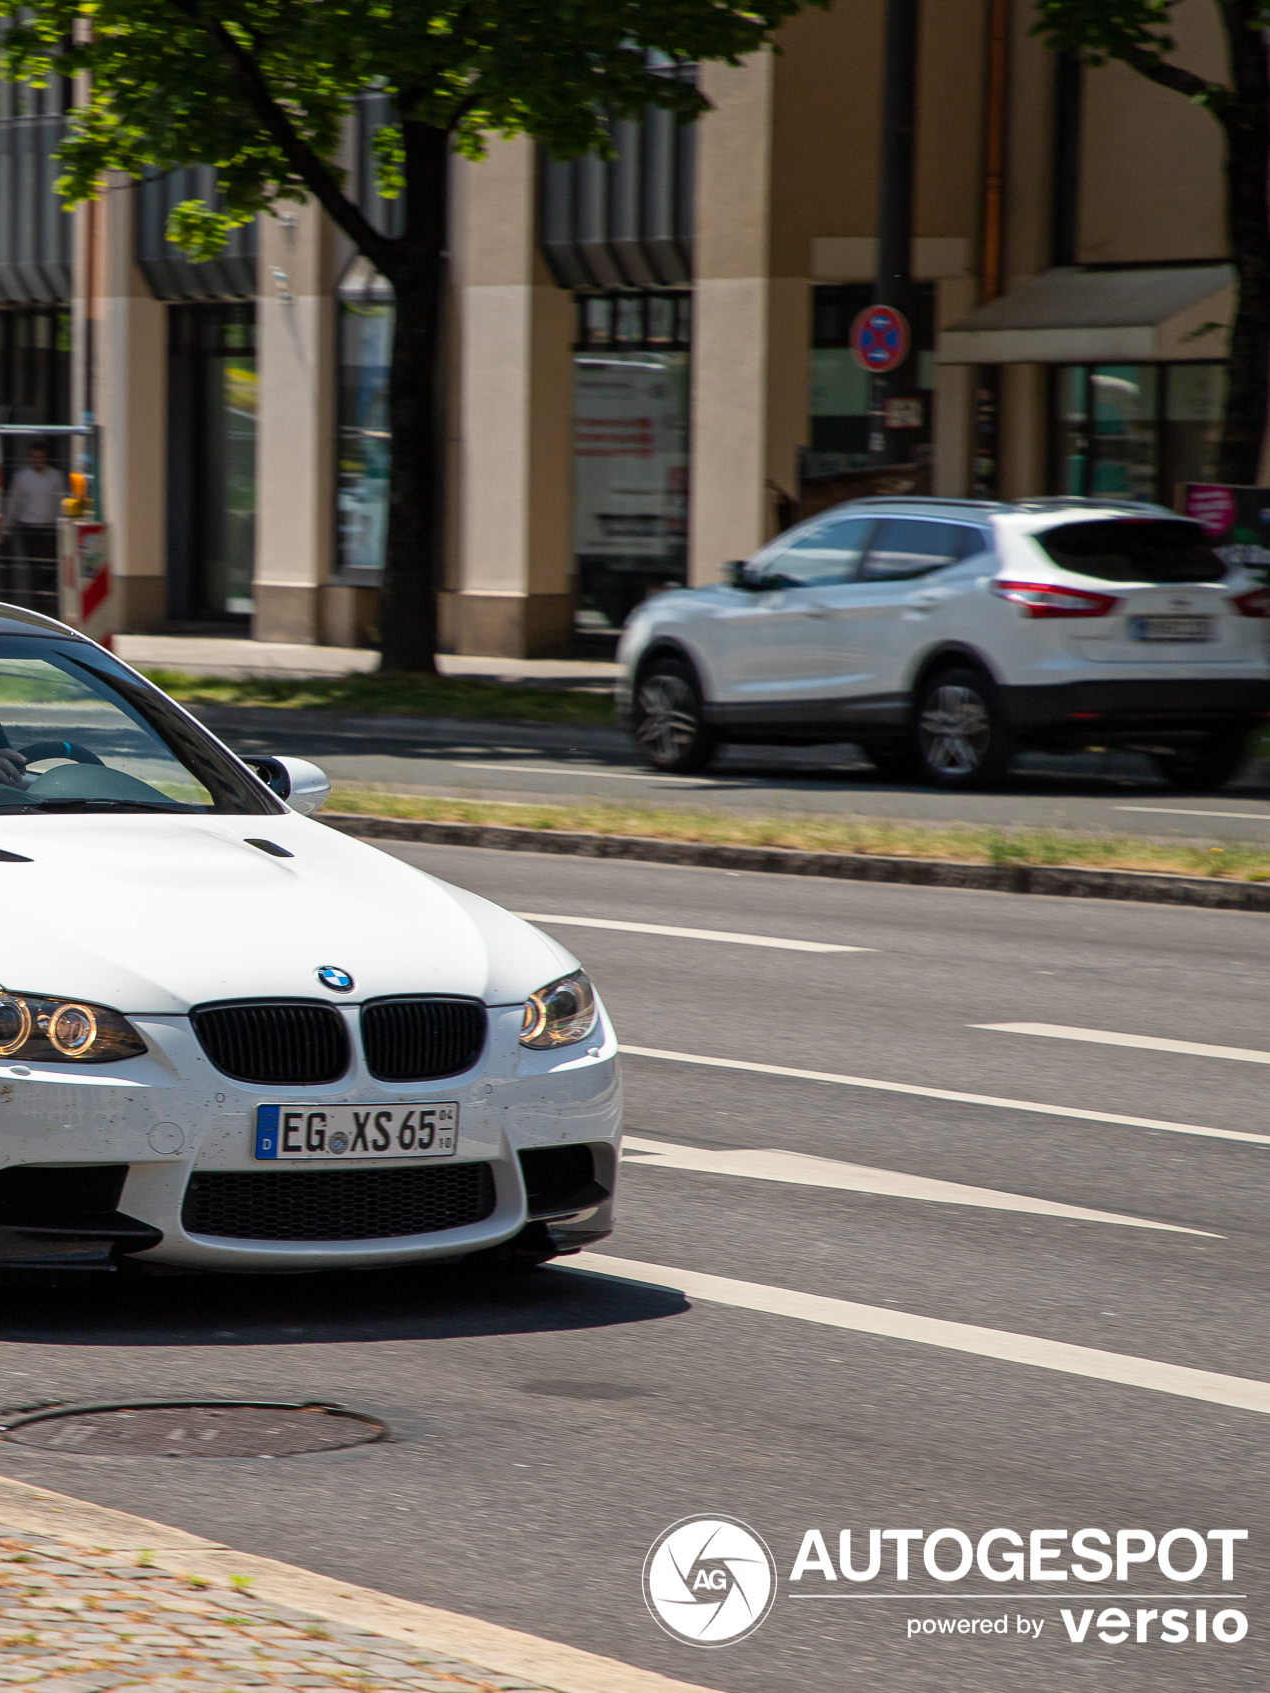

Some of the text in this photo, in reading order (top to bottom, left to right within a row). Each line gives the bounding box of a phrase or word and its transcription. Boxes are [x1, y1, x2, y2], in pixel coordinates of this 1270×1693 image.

[261, 1138, 273, 1150] D
[282, 1109, 437, 1152] EG XS 65
